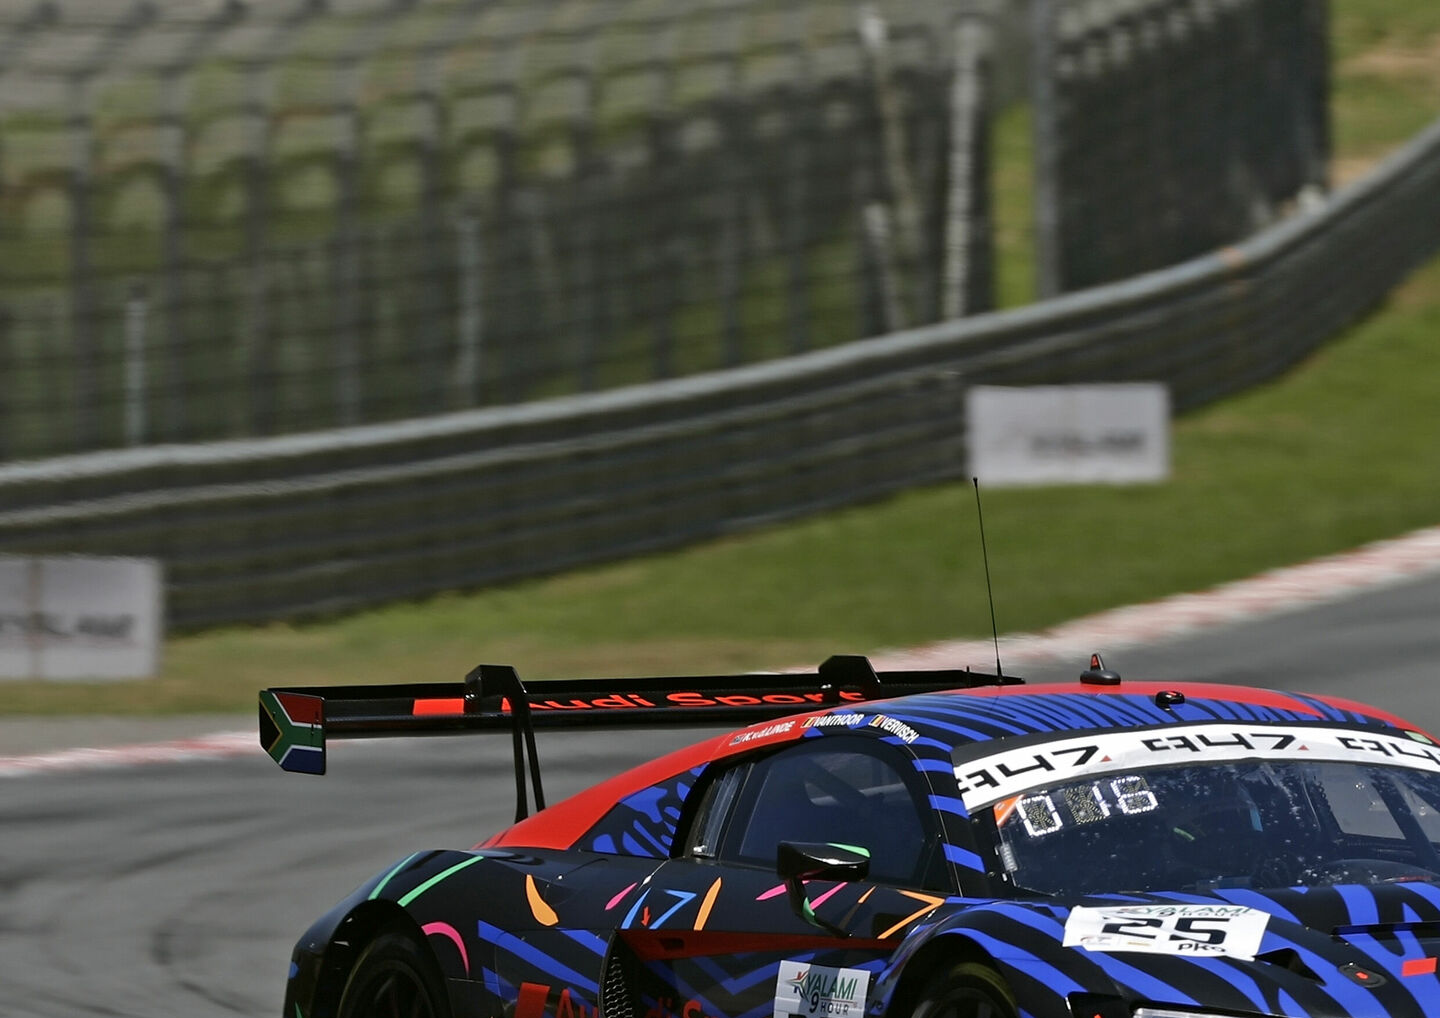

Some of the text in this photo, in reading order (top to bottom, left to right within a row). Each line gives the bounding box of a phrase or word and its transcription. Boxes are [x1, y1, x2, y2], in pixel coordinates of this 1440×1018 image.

[813, 713, 865, 728] VANTHOOR
[879, 717, 920, 745] VERVISCH
[1102, 917, 1231, 946] 25
[786, 970, 859, 1002] KYALAMI
[809, 991, 850, 1016] 9 HOUR
